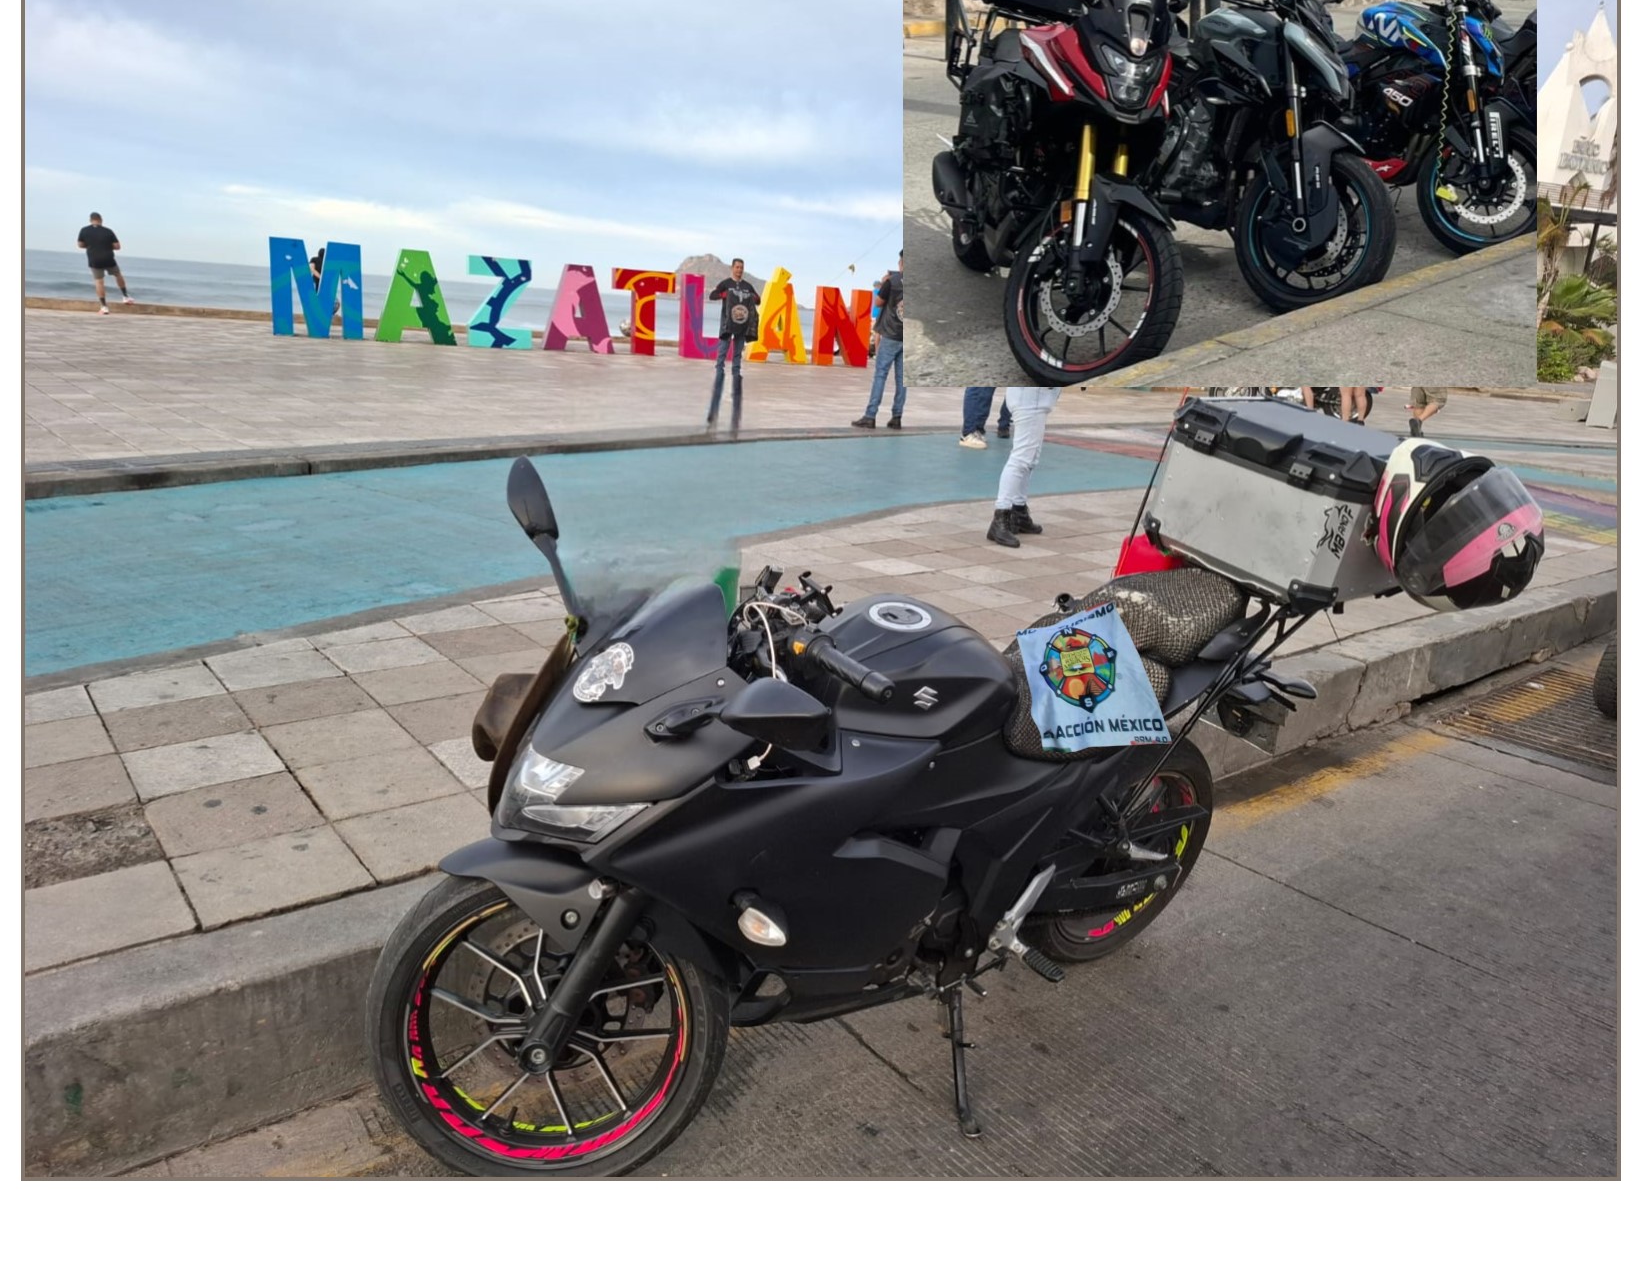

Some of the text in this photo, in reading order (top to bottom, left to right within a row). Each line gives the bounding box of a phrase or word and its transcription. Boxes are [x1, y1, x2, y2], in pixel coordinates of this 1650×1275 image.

[1382, 87, 1414, 107] 450
[269, 235, 873, 368] MAZATLÁN
[1084, 697, 1093, 707] S
[1109, 714, 1164, 733] MÉXICO
